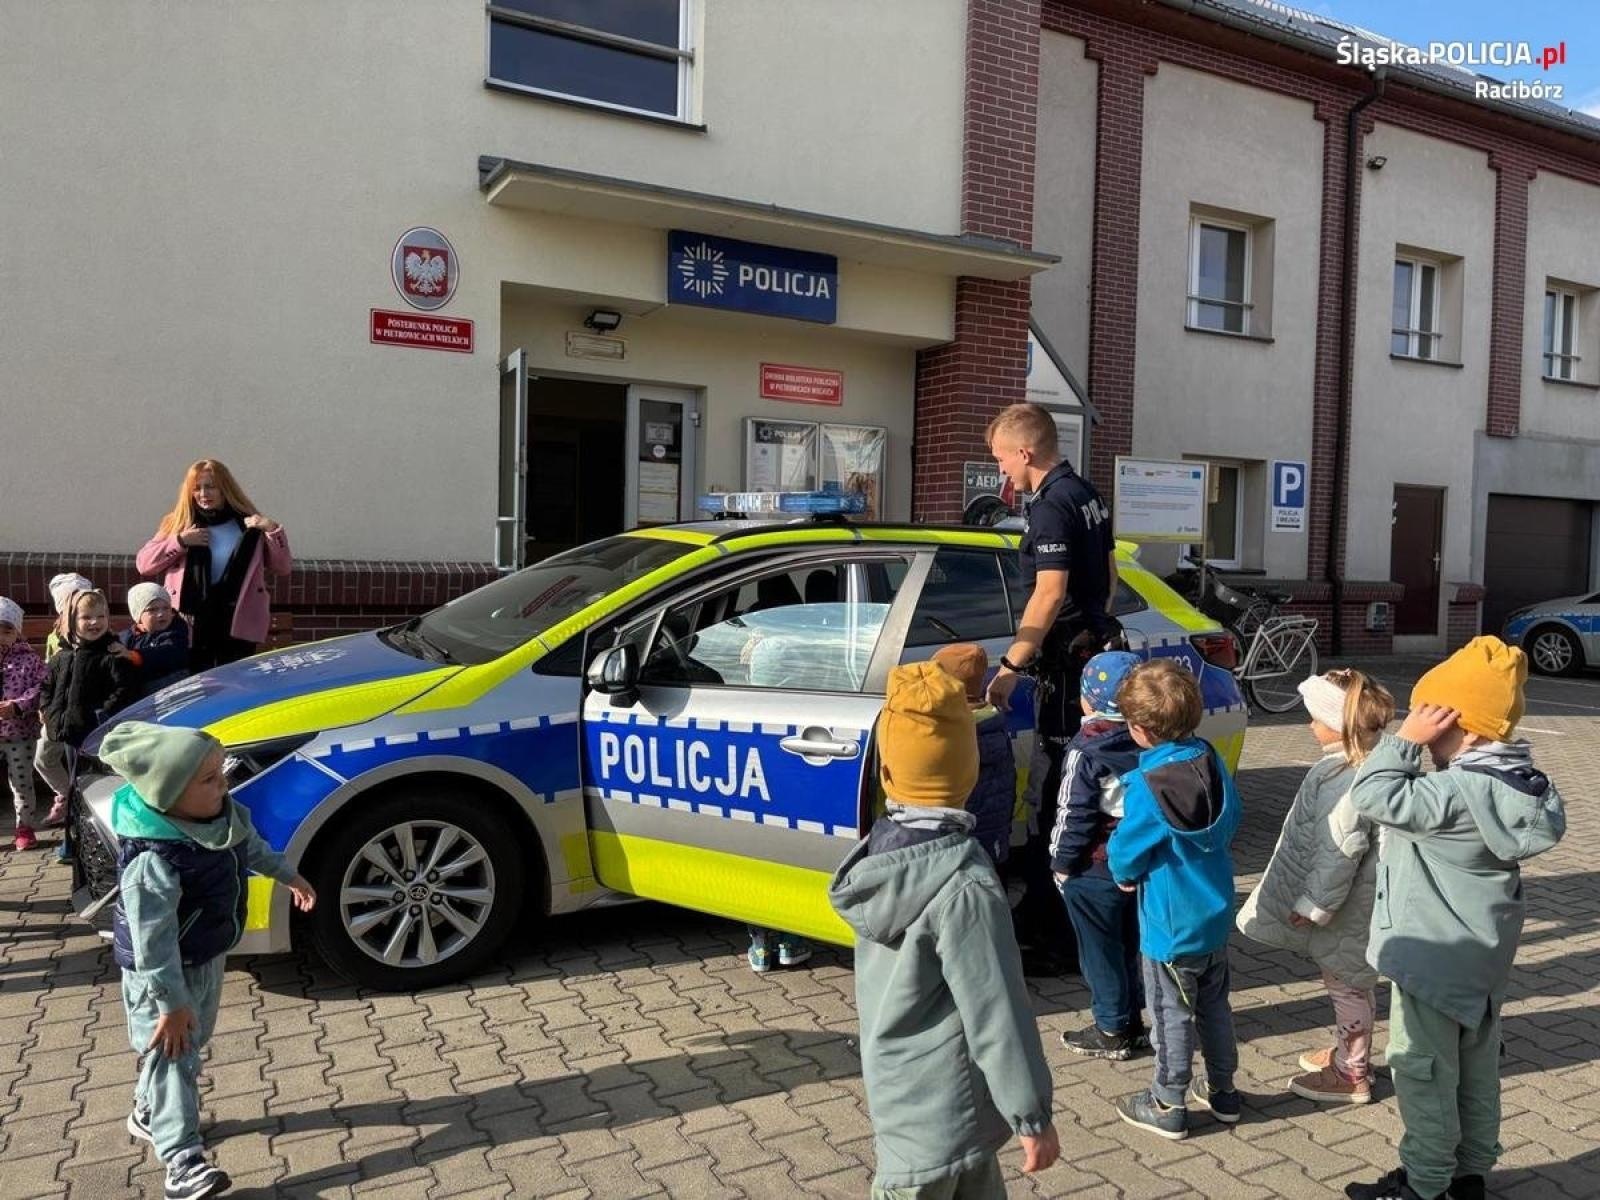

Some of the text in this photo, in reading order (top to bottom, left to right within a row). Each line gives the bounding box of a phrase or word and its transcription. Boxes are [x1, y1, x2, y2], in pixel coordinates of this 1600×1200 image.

[739, 264, 831, 299] POLICJA
[388, 318, 431, 332] POSTERUNEK
[375, 328, 382, 336] W
[976, 475, 998, 488] AED
[1280, 465, 1302, 505] P
[1278, 509, 1298, 517] POLICJA
[1036, 542, 1068, 554] POLICJA
[599, 731, 772, 802] POLICJA
